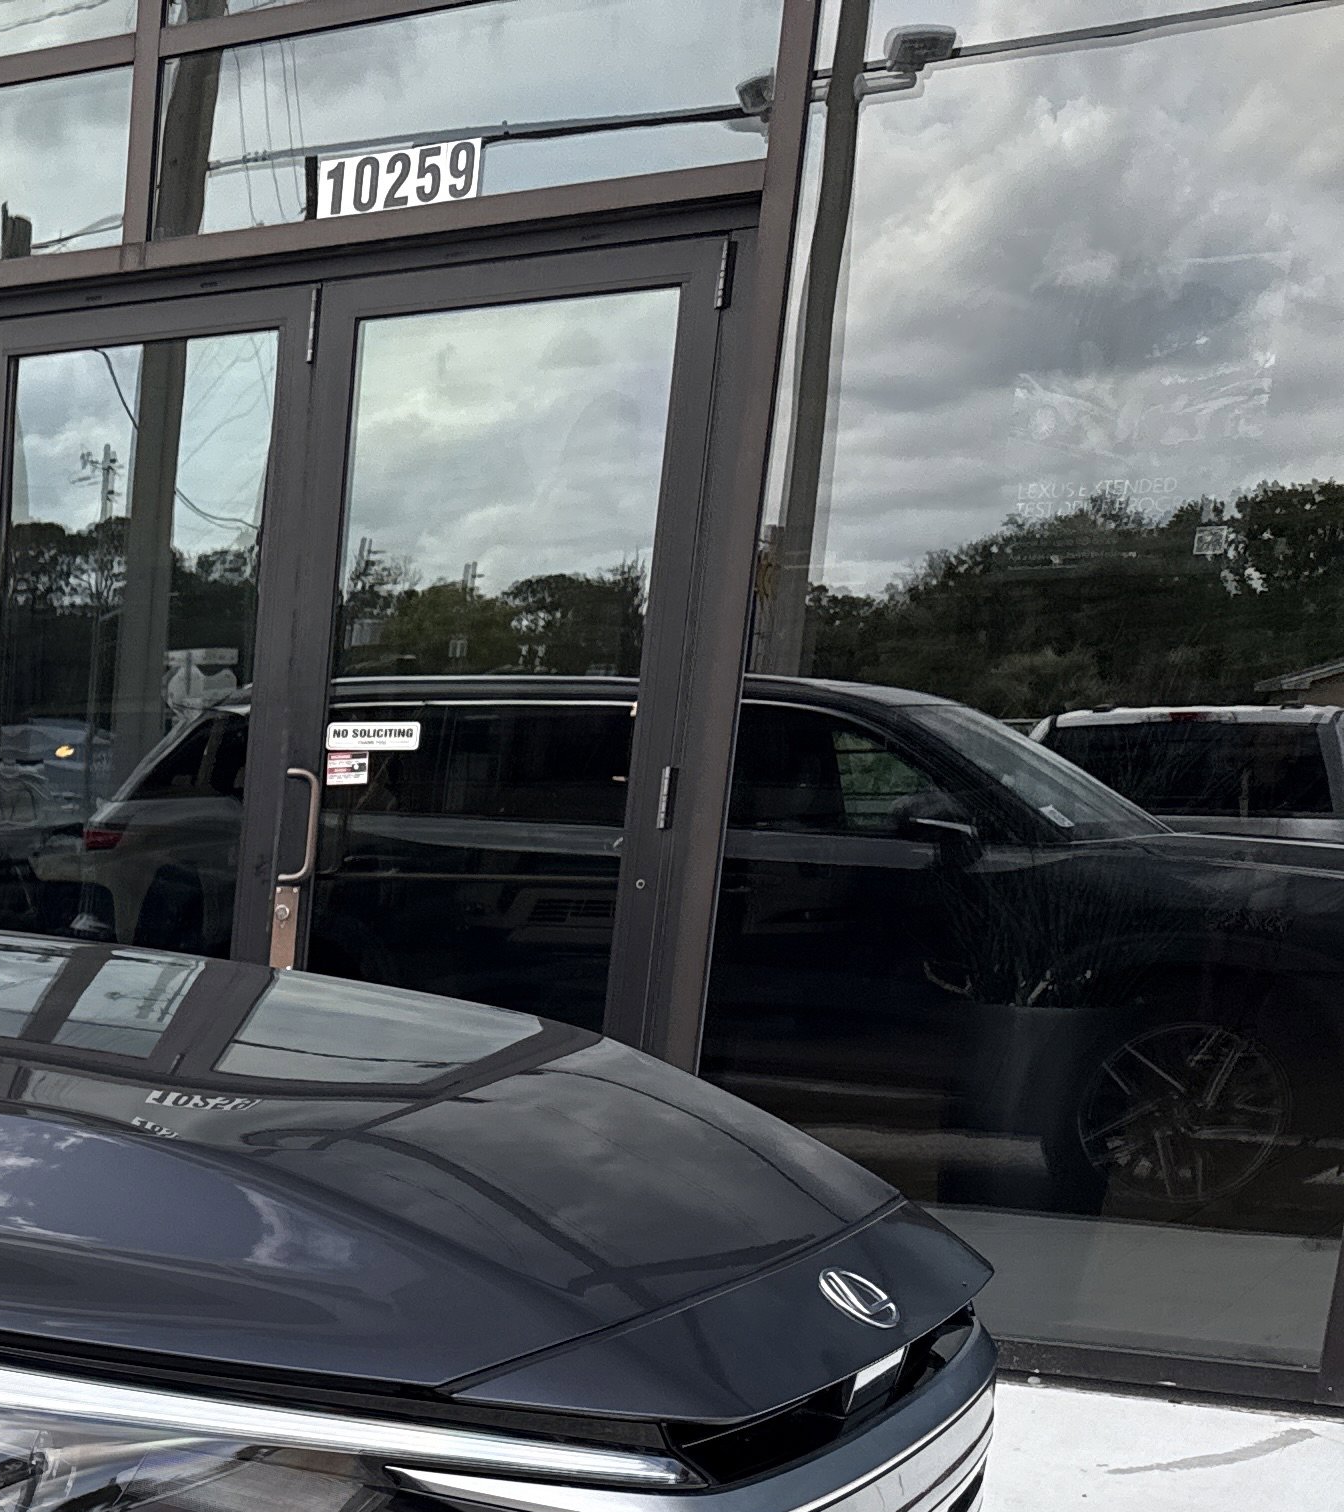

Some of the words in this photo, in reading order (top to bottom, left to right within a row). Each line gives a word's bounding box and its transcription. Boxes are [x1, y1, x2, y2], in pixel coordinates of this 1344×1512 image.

[326, 141, 476, 215] 10259
[332, 728, 348, 738] NO
[352, 728, 413, 738] SOLICITING
